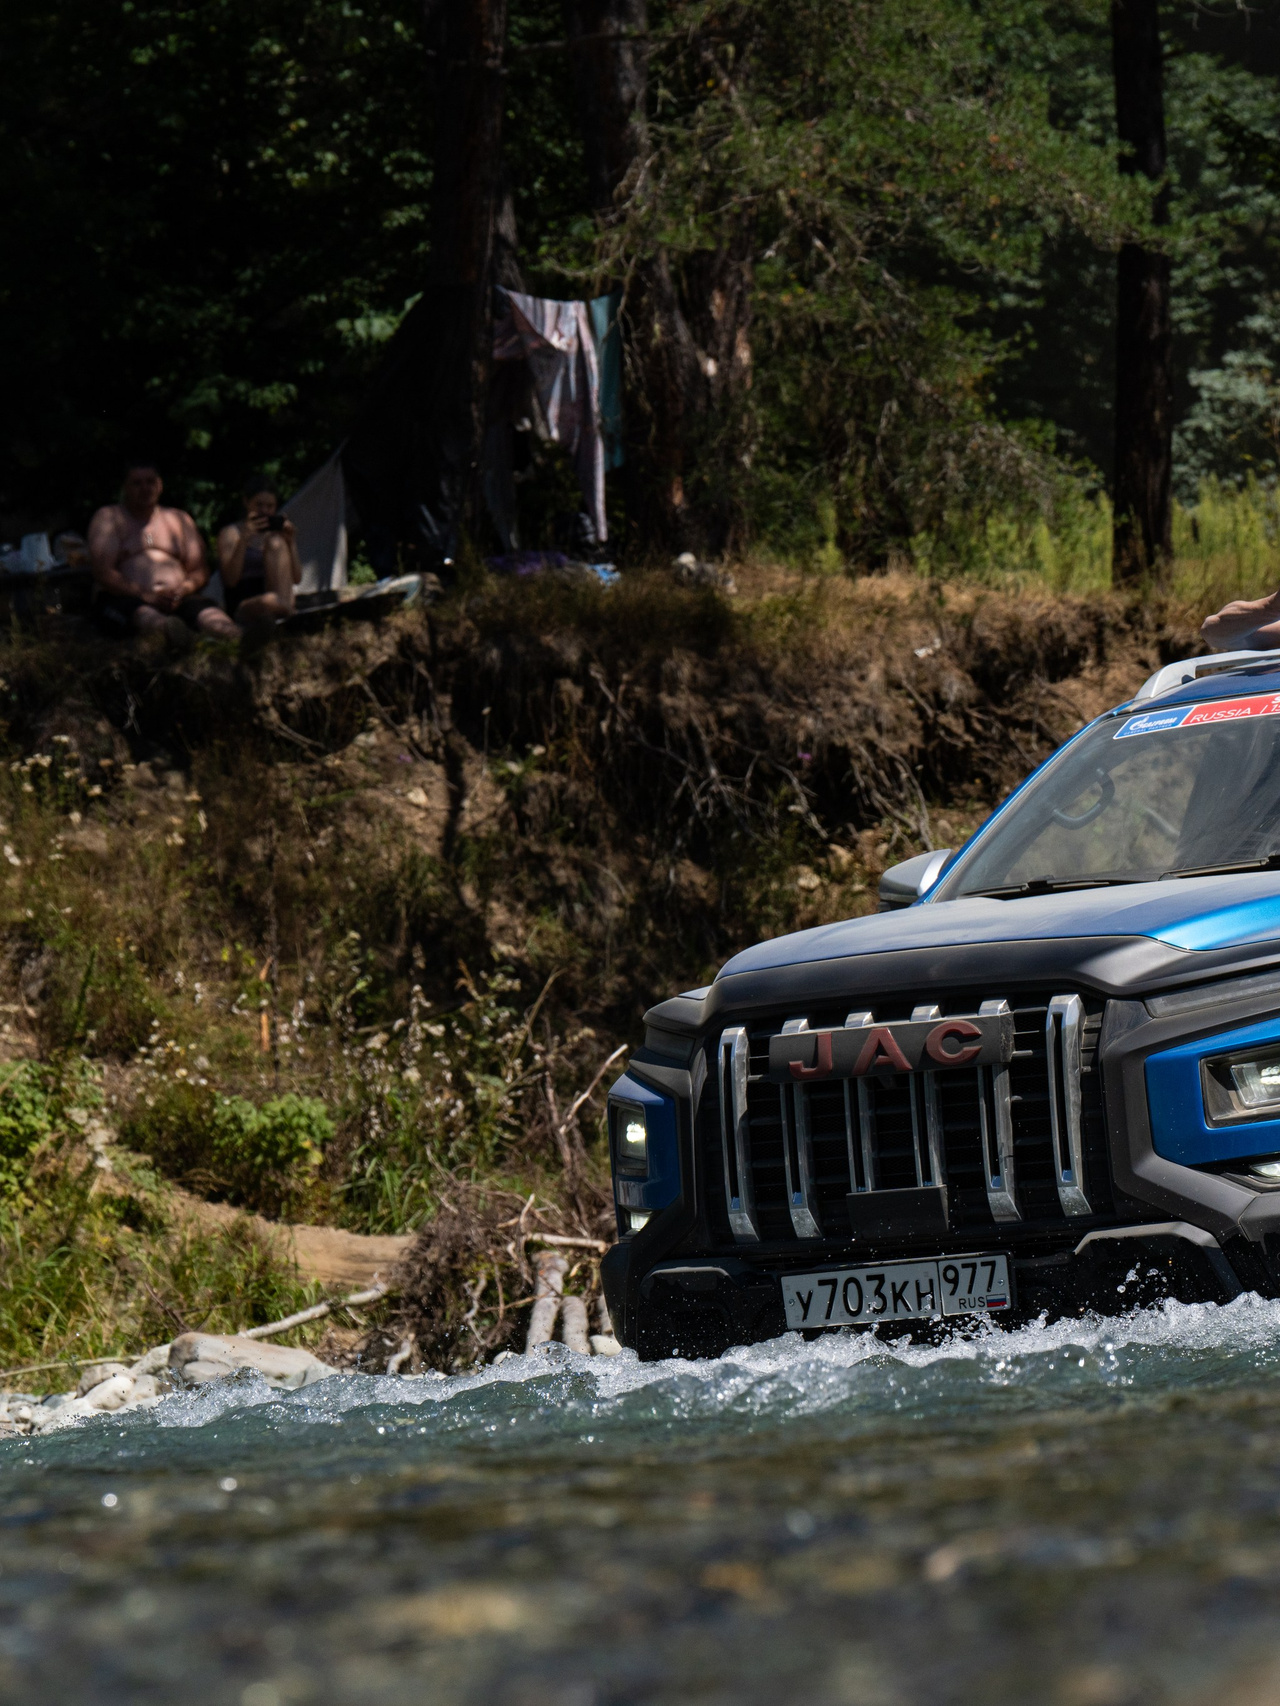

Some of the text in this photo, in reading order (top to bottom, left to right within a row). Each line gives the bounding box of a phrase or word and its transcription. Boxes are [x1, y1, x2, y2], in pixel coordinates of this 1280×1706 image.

[1189, 707, 1251, 723] RUSSIA
[788, 1019, 983, 1080] JAC
[943, 1260, 997, 1297] 977
[959, 1297, 986, 1309] RUS
